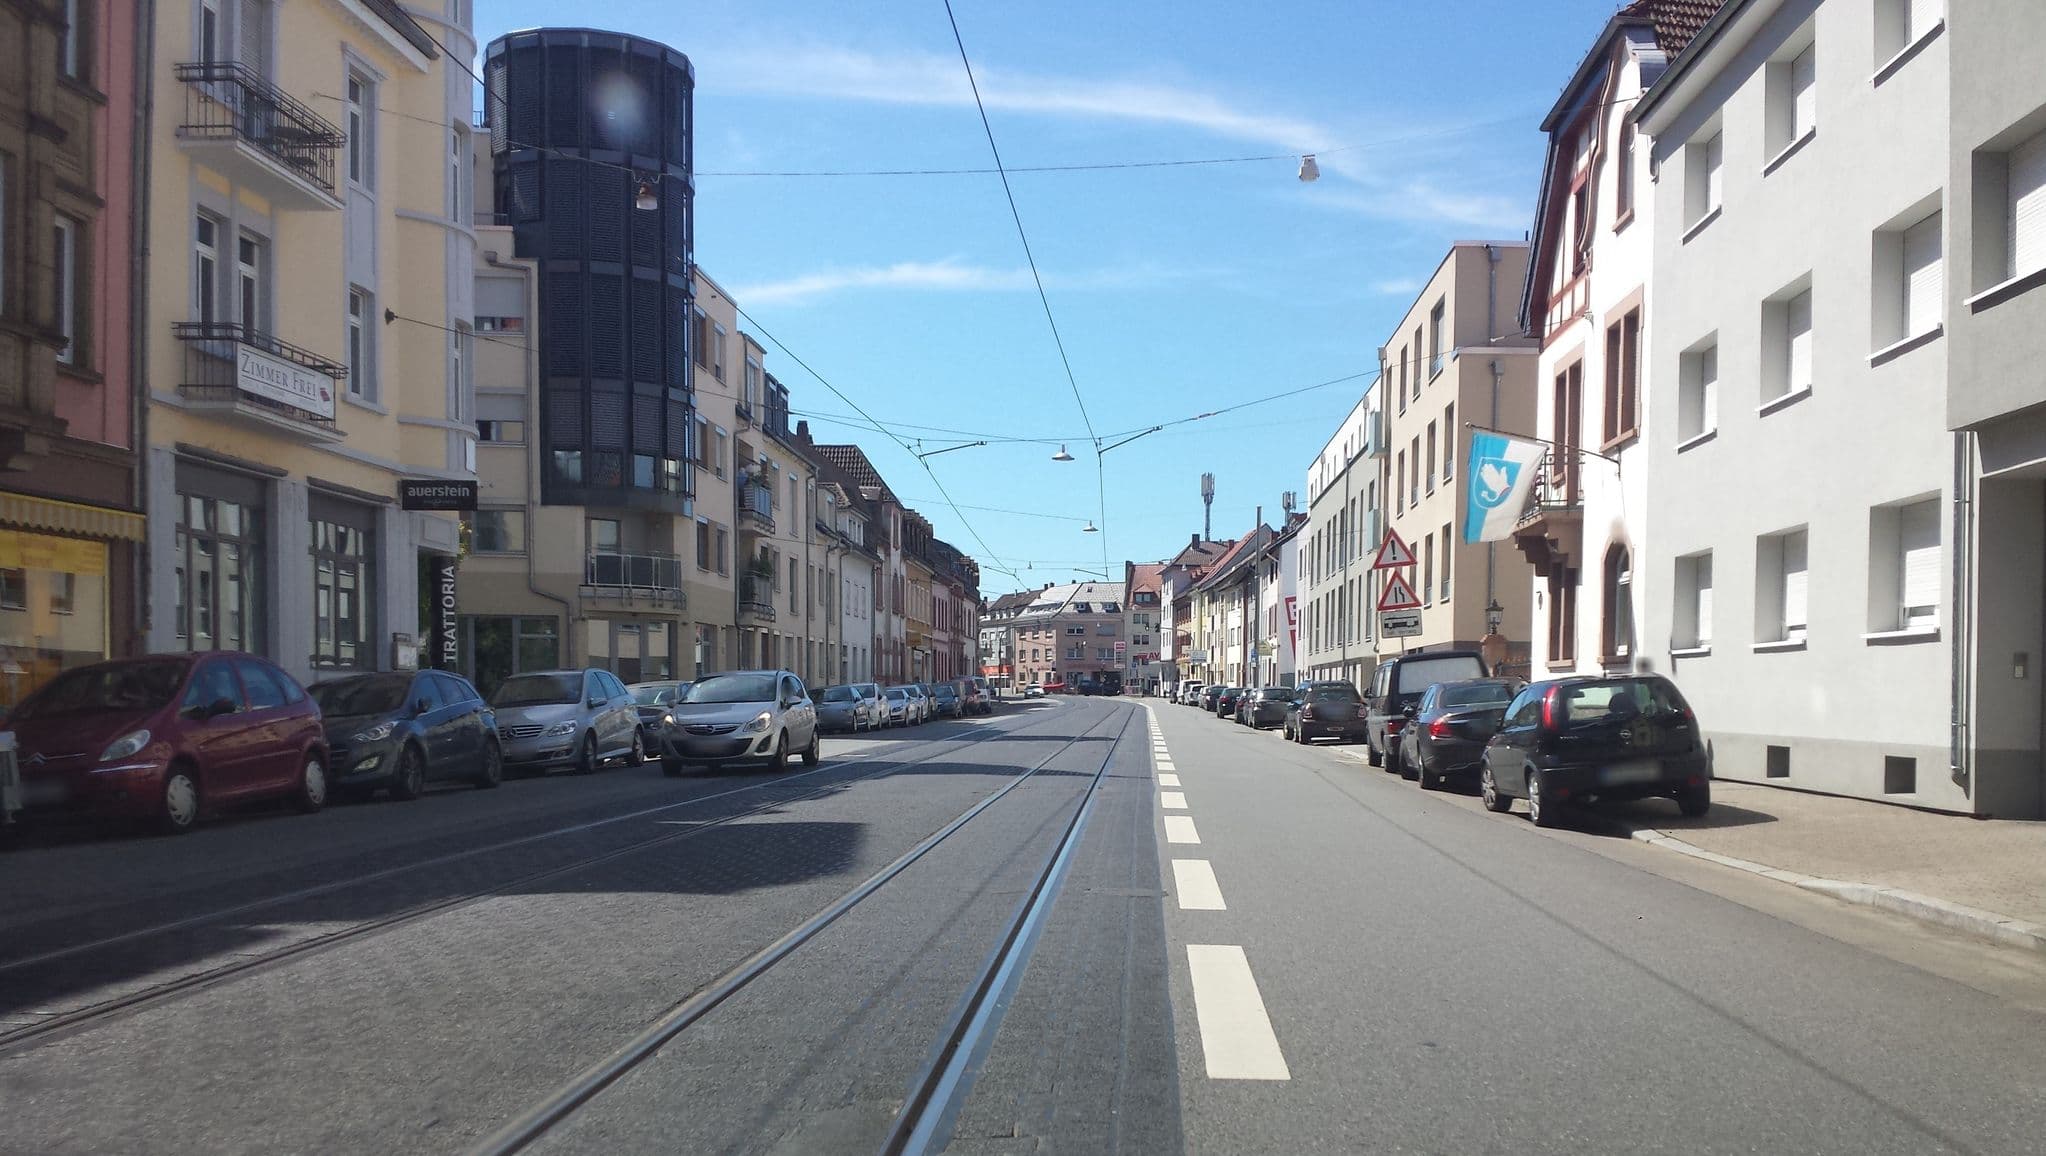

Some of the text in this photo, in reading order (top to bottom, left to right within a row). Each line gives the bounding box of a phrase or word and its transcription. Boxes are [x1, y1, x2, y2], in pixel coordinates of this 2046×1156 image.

[241, 353, 317, 397] ZIMMER FREI
[407, 484, 470, 497] auerstein
[441, 565, 456, 663] TRATTORIA
